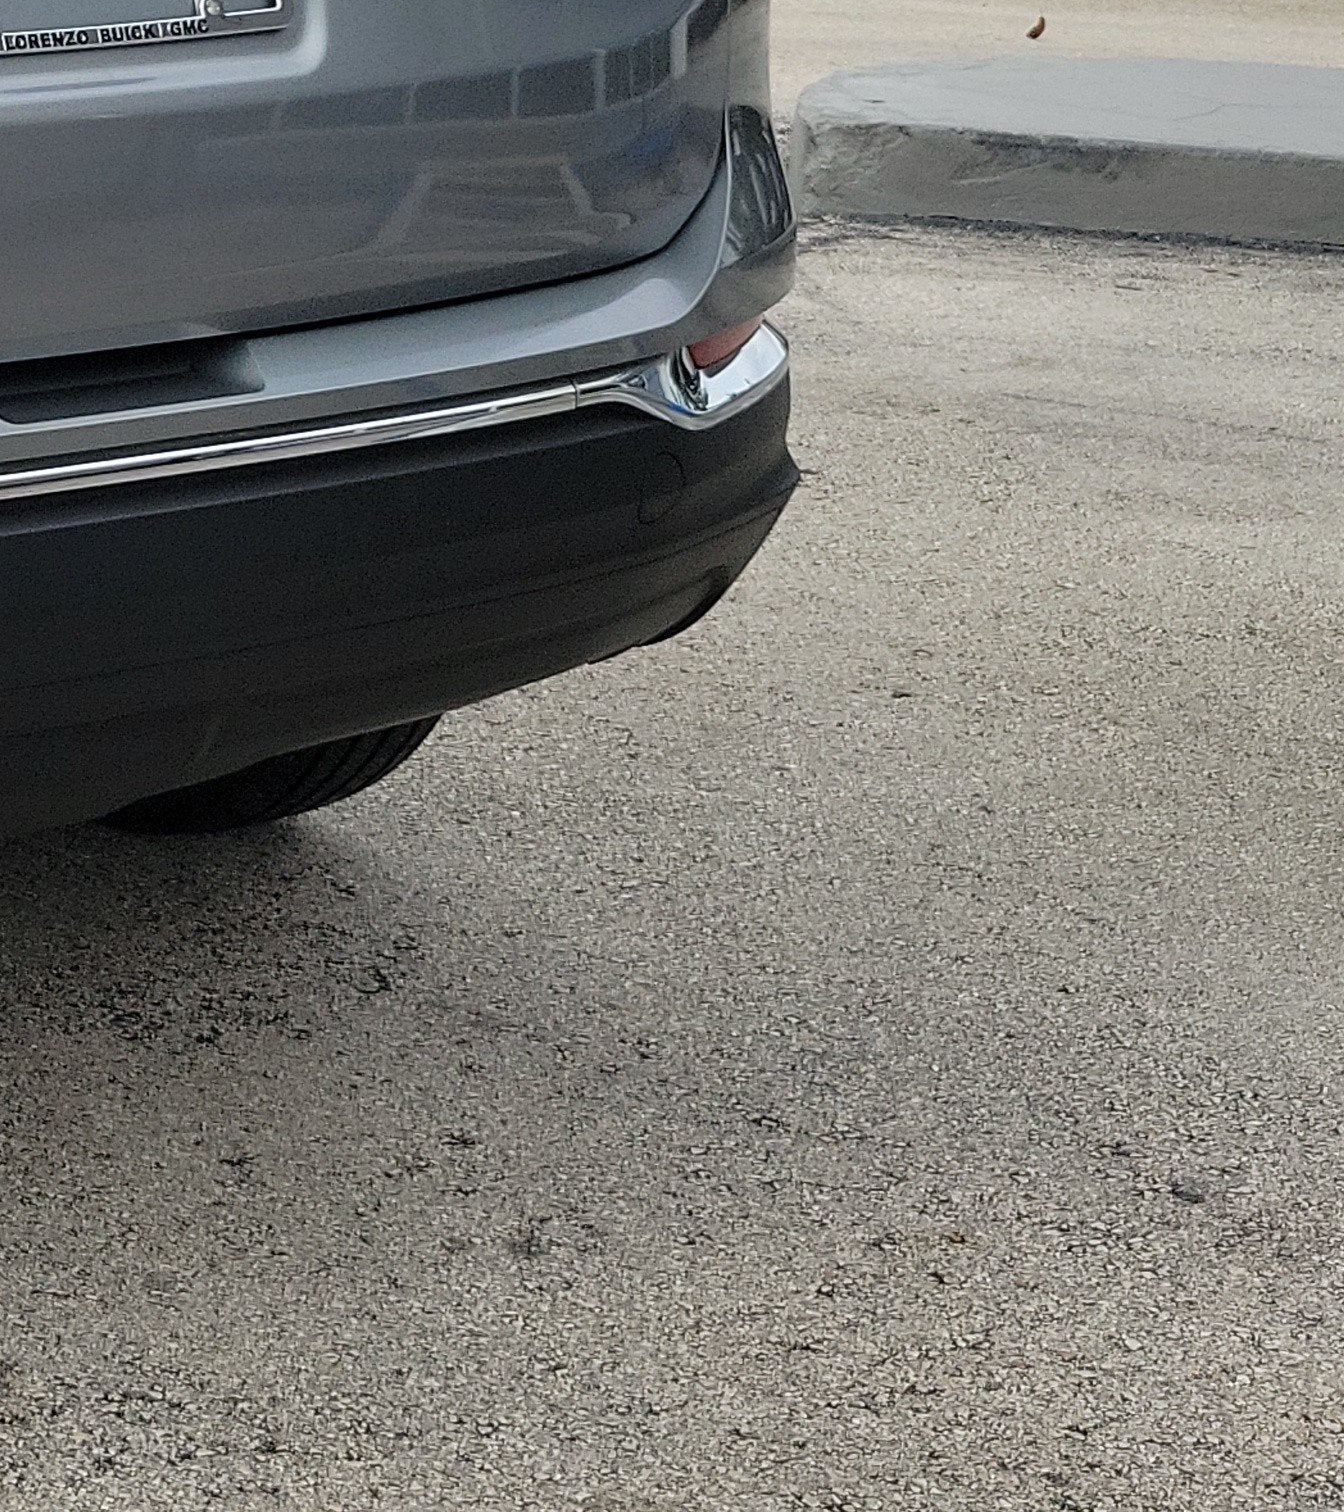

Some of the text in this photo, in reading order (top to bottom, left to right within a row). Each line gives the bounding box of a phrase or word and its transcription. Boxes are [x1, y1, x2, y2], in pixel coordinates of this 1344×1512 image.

[5, 18, 210, 51] LORENZO BUICK GMC
